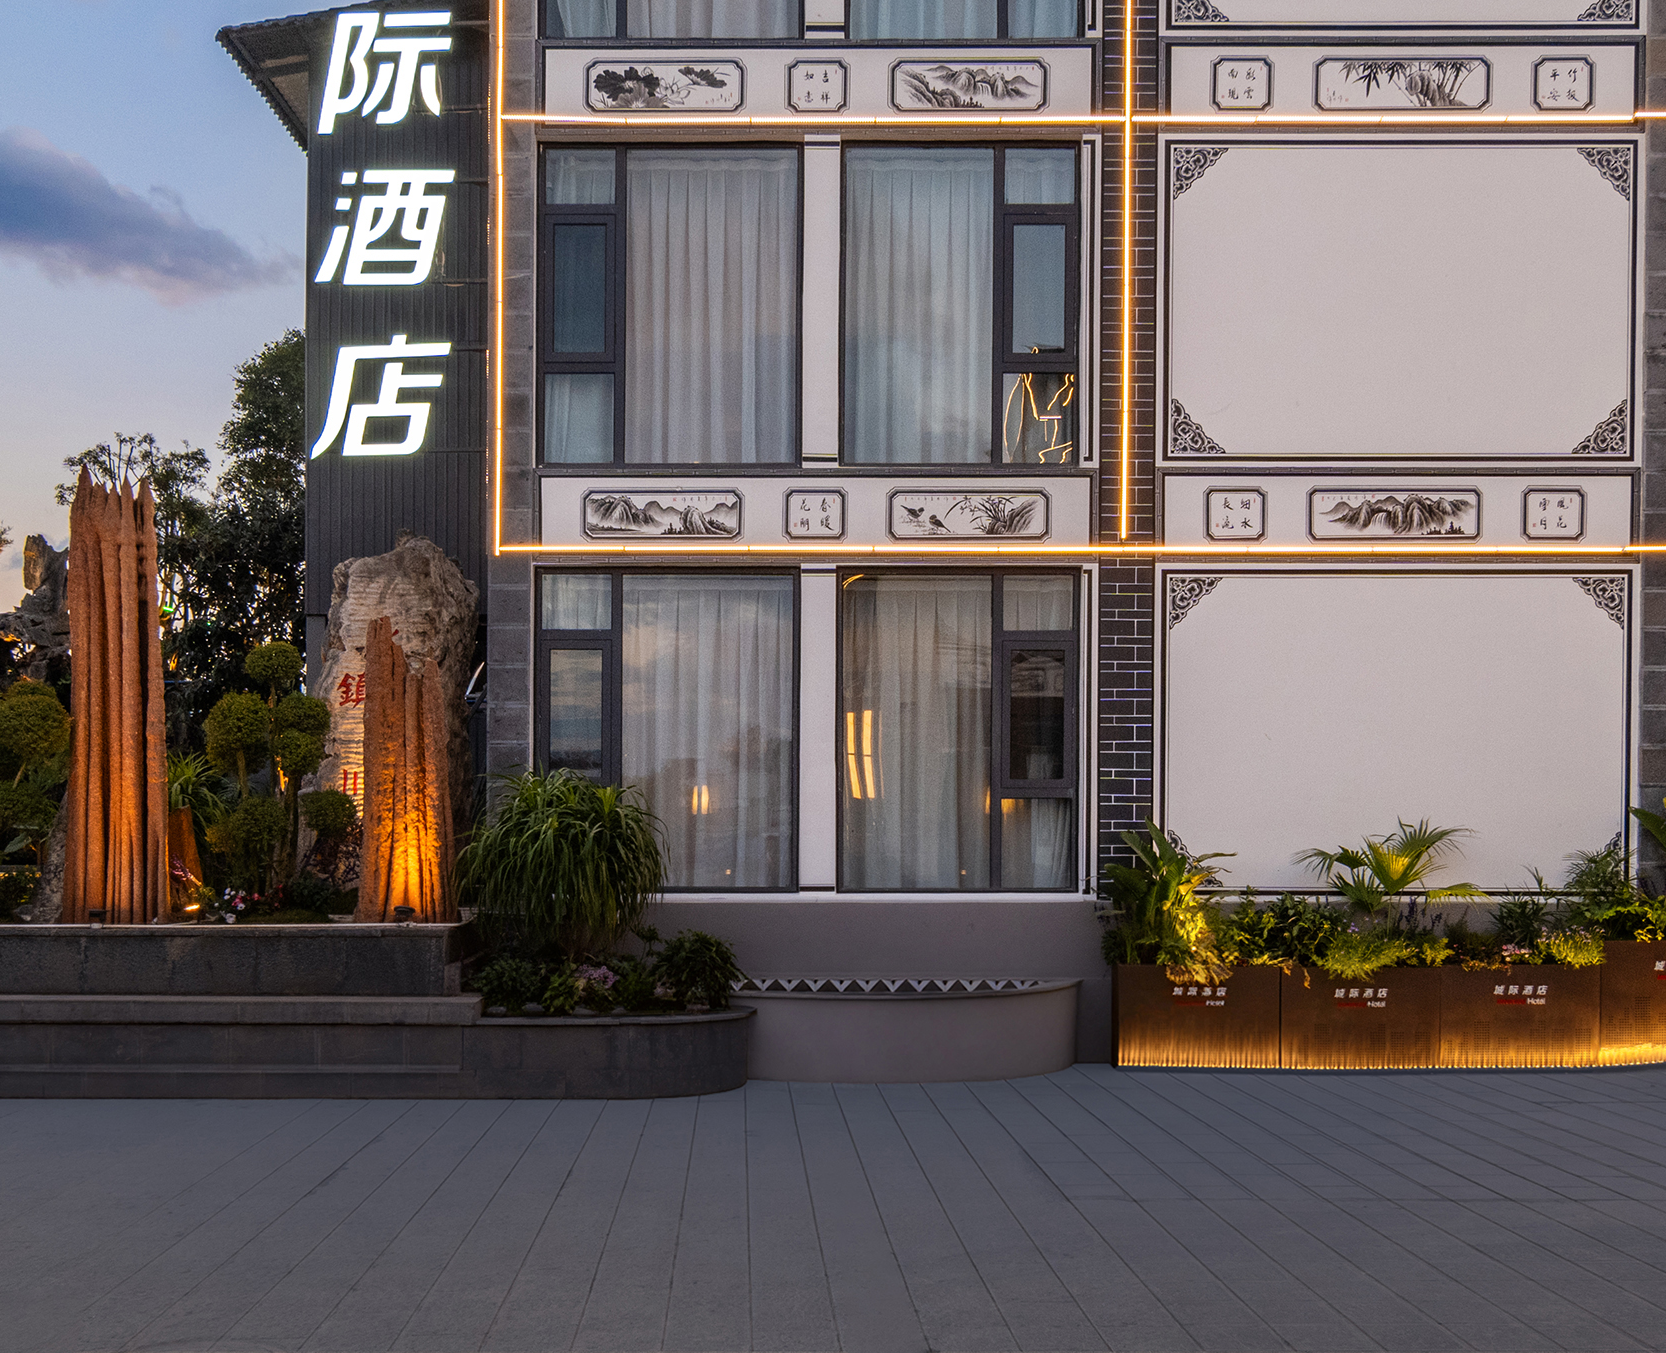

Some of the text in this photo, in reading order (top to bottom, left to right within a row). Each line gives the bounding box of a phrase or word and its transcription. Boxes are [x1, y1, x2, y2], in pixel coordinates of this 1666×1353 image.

[1334, 988, 1389, 999] 城际酒店
[1493, 985, 1548, 995] 城际酒店
